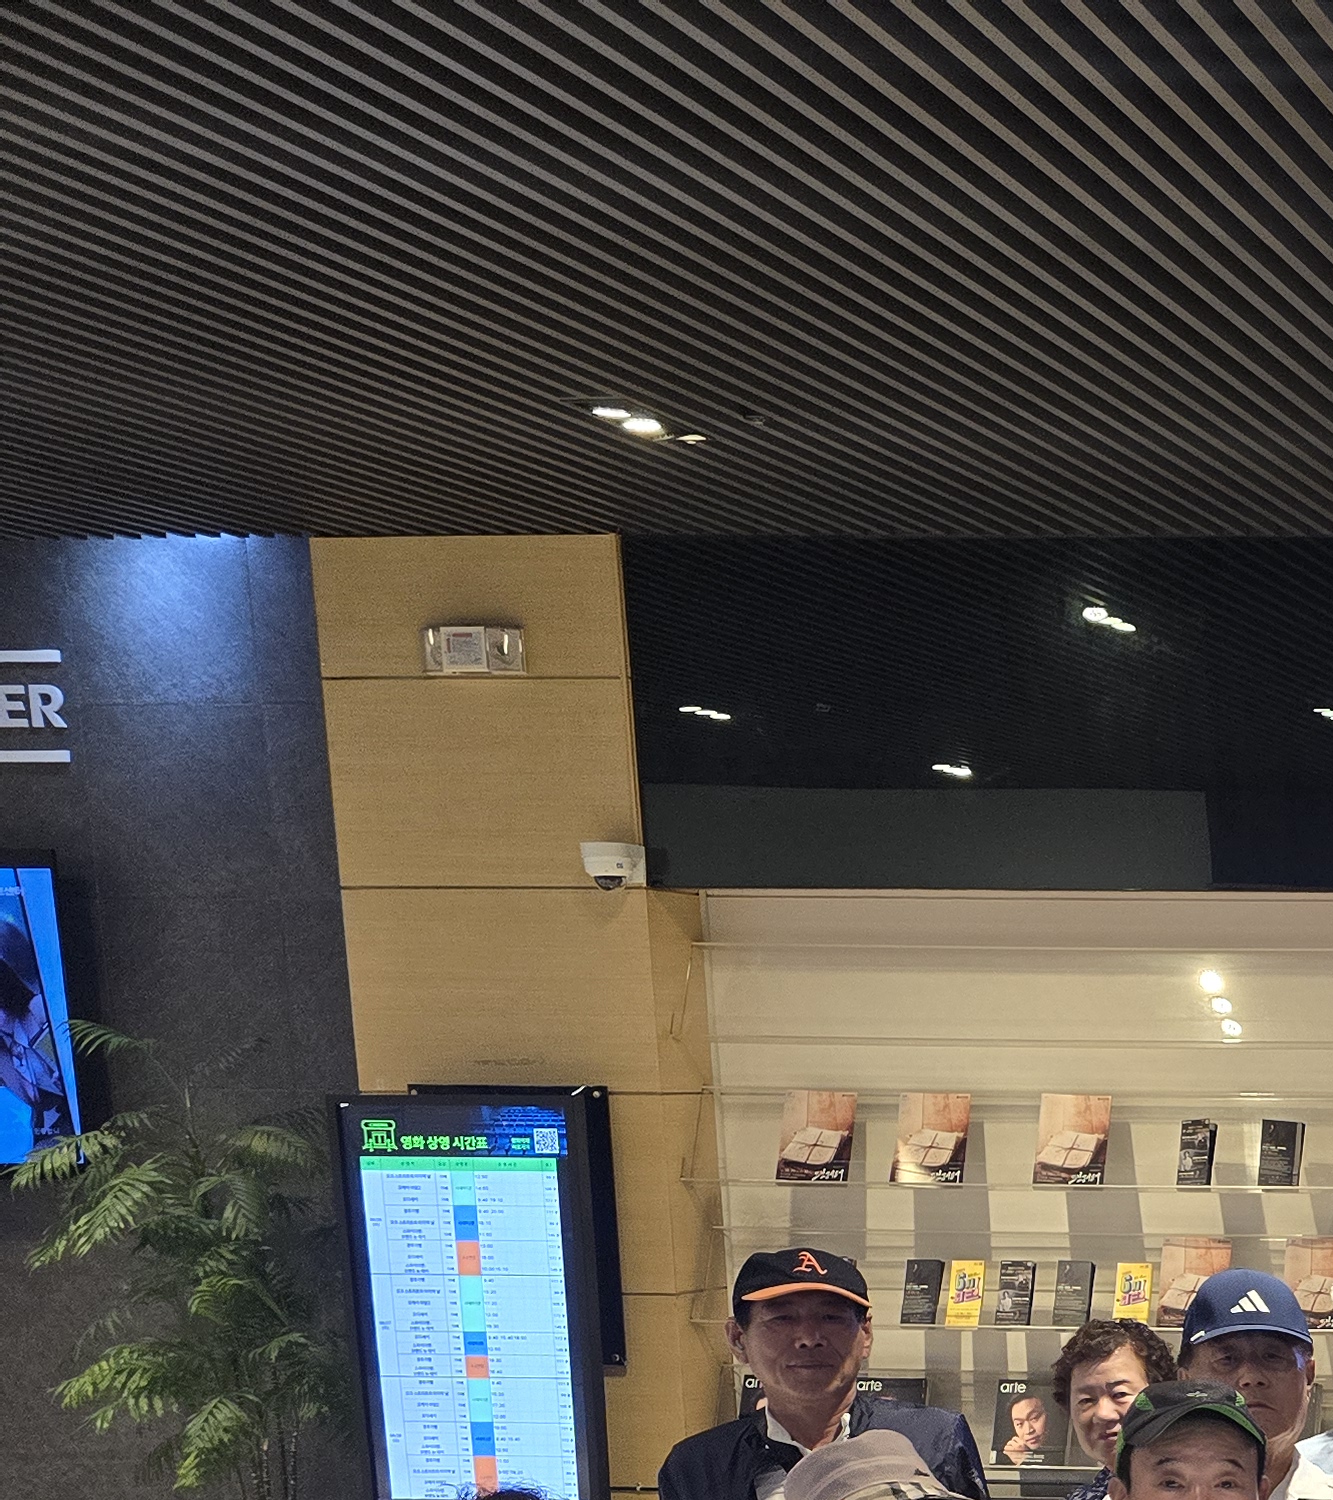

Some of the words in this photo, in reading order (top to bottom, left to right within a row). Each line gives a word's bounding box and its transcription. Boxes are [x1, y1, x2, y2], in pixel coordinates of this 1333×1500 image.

[400, 1135, 425, 1150] 영화
[427, 1135, 450, 1150] 상영
[453, 1135, 488, 1150] 시간표
[792, 1251, 828, 1275] A
[857, 1380, 882, 1391] arte
[1000, 1381, 1026, 1393] arte
